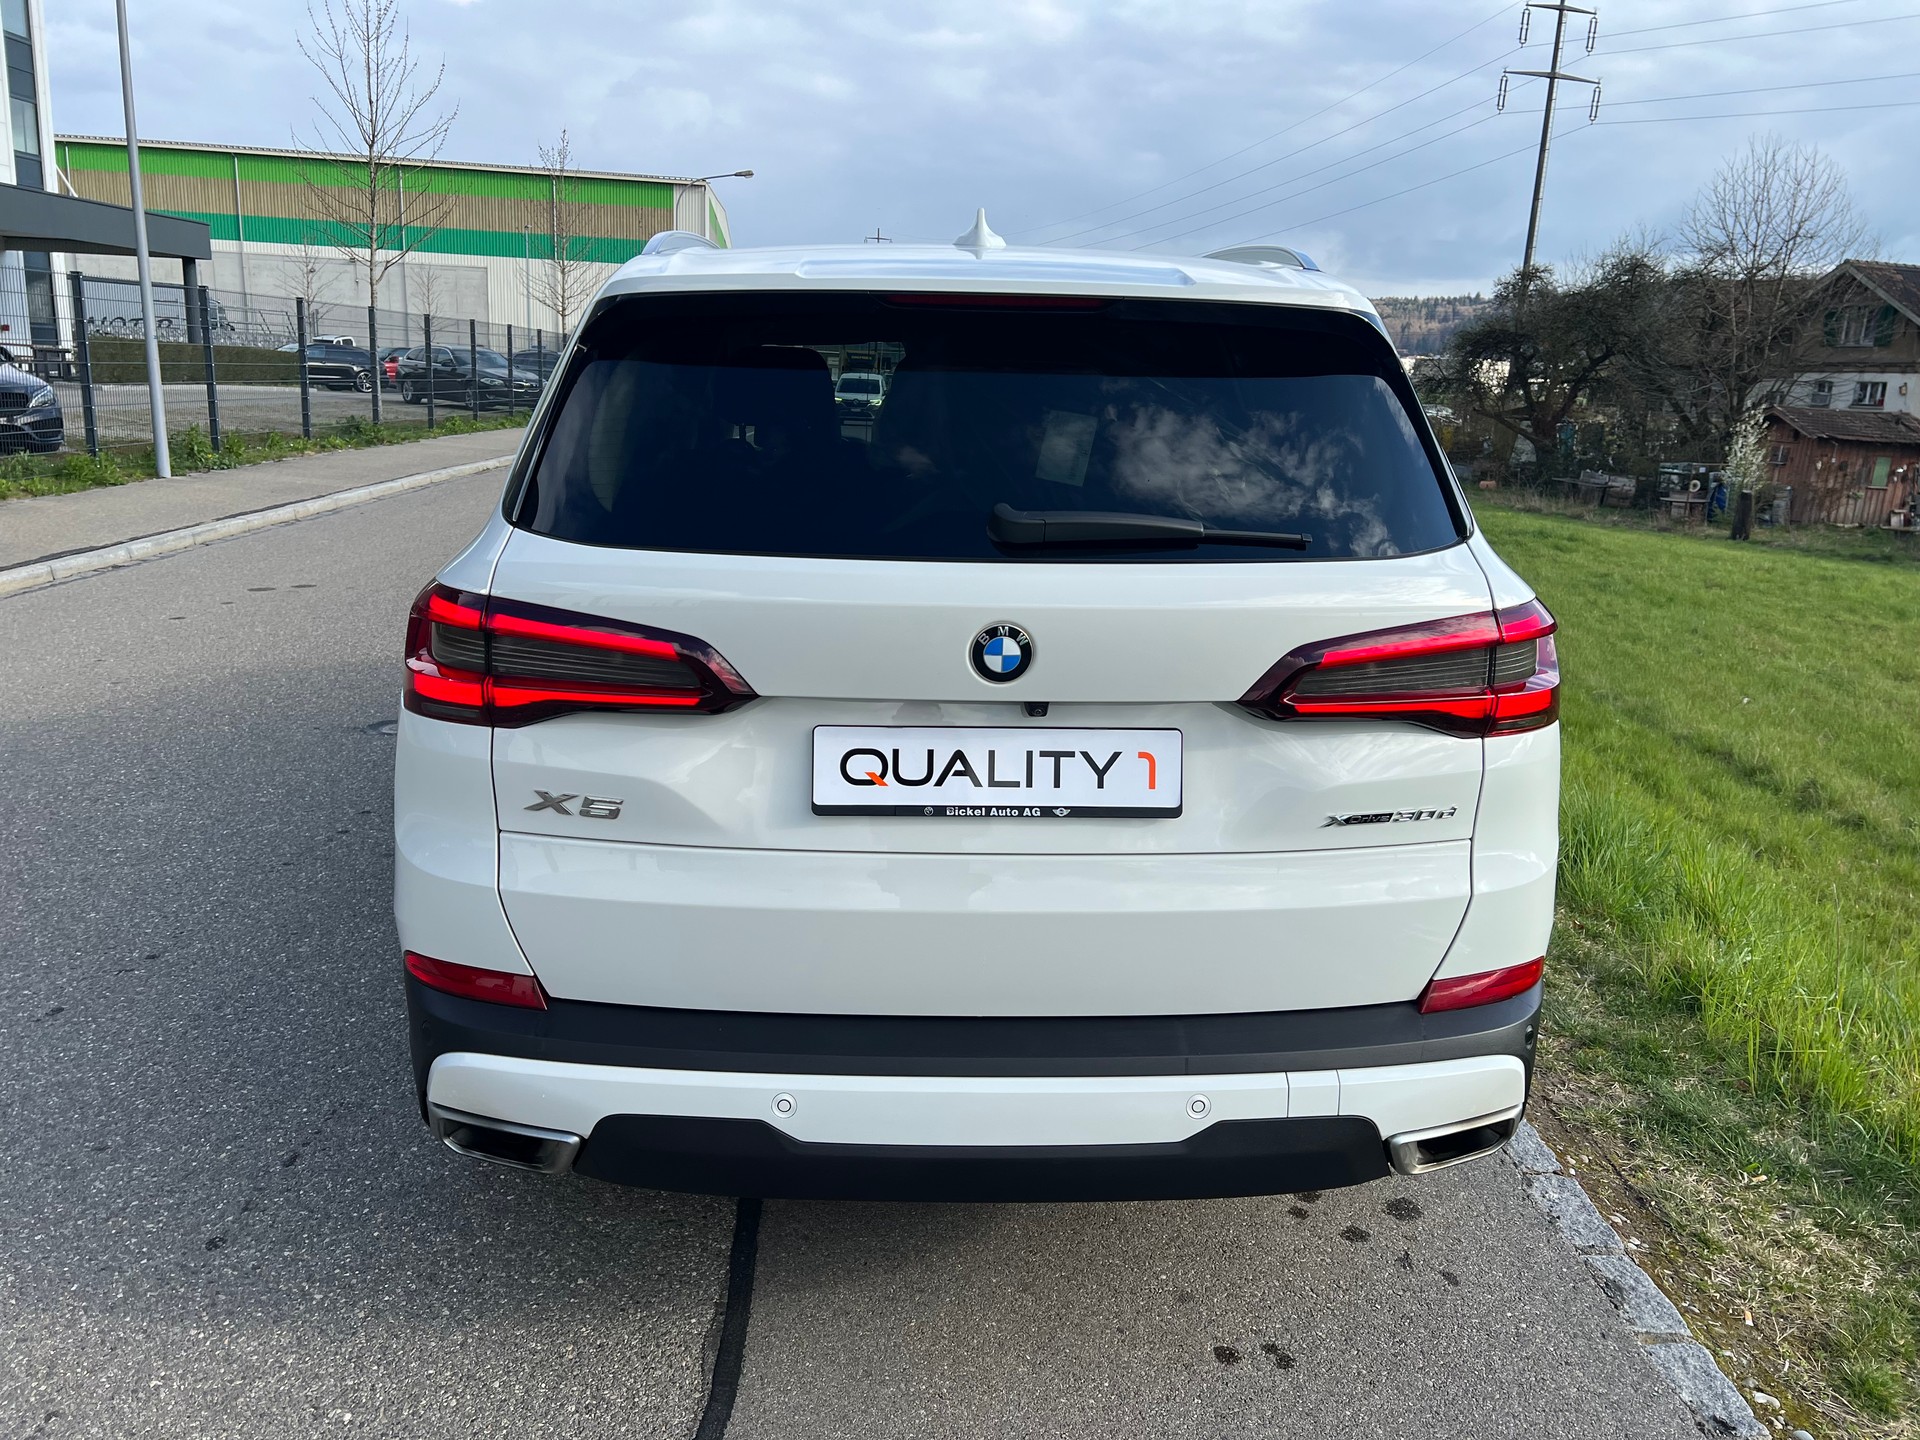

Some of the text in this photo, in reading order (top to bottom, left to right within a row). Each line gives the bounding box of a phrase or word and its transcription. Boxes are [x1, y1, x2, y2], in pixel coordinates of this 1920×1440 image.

[978, 625, 1029, 646] BMW
[840, 748, 1156, 790] QUALITY 1
[523, 789, 624, 820] X5
[946, 806, 1041, 817] Bickel Auto AG
